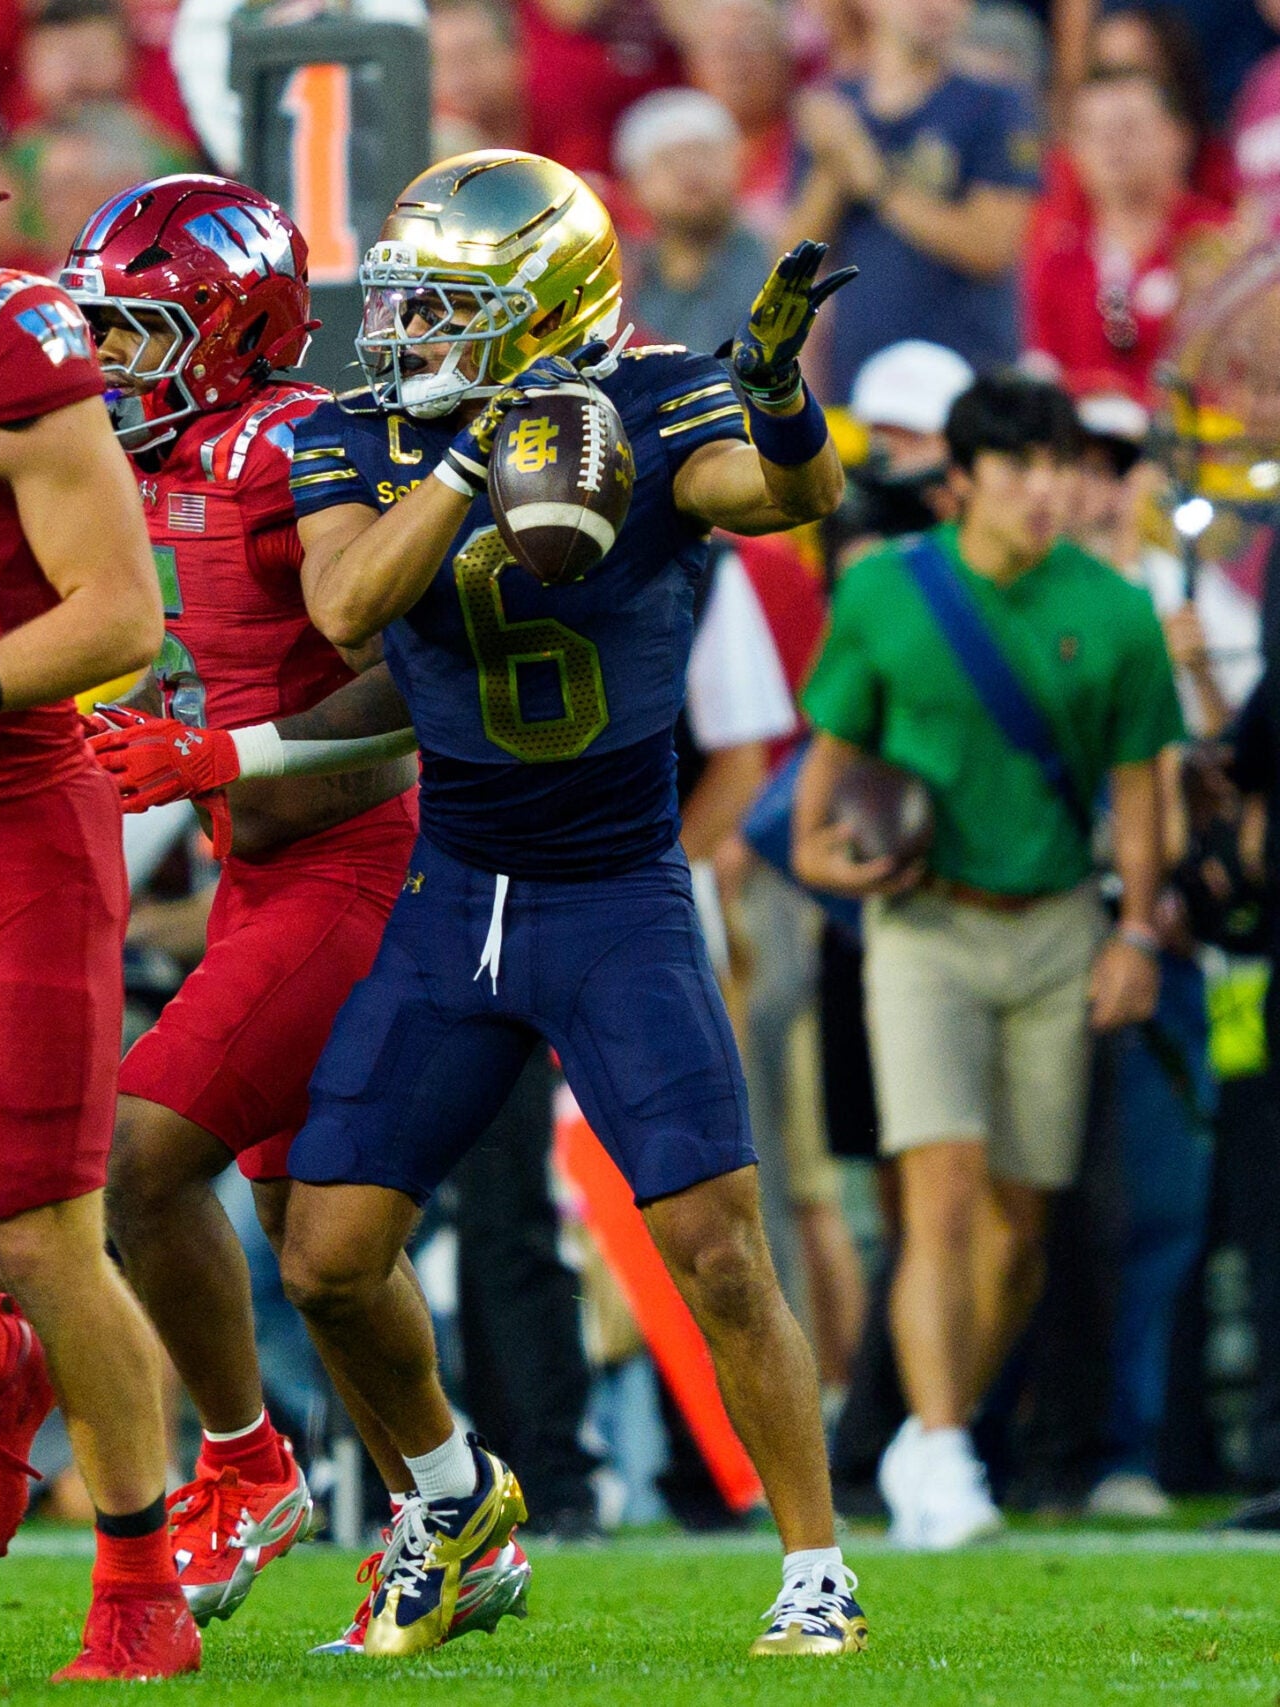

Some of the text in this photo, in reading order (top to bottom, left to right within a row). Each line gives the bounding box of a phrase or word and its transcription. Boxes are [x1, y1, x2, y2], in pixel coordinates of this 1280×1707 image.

[276, 60, 359, 284] 1
[387, 415, 423, 465] C
[452, 522, 610, 764] 6
